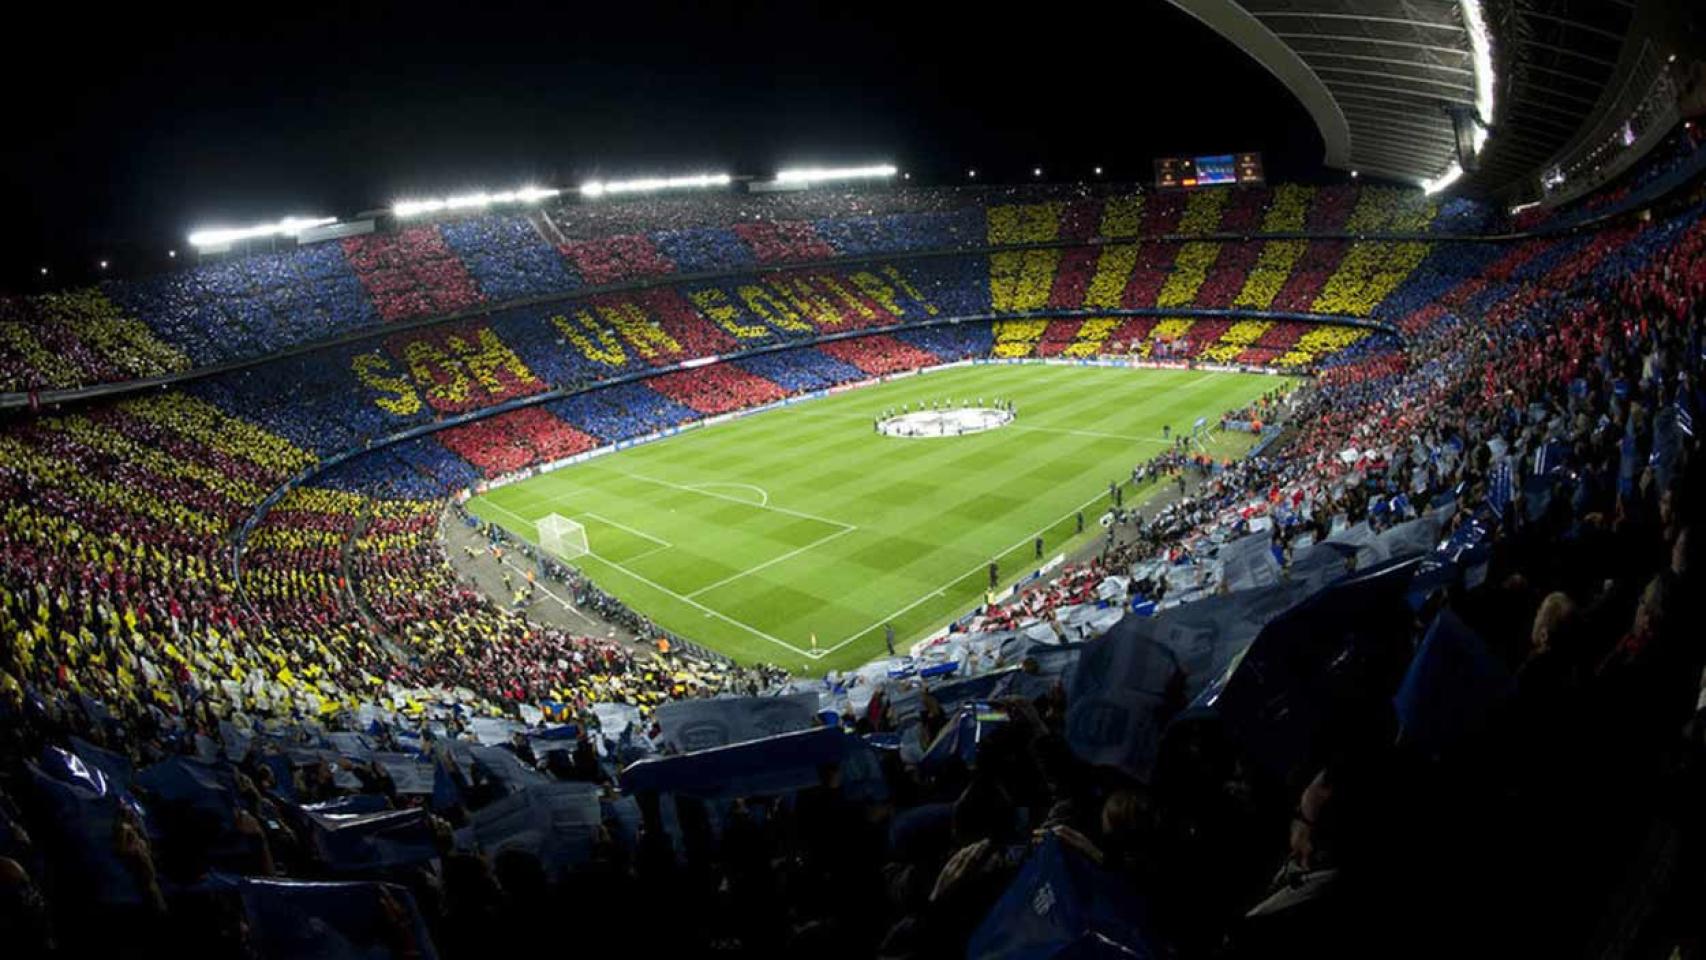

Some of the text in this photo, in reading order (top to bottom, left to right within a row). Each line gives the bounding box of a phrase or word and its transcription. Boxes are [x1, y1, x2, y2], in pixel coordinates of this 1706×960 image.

[351, 264, 939, 415] SOM UN EQUIP!
